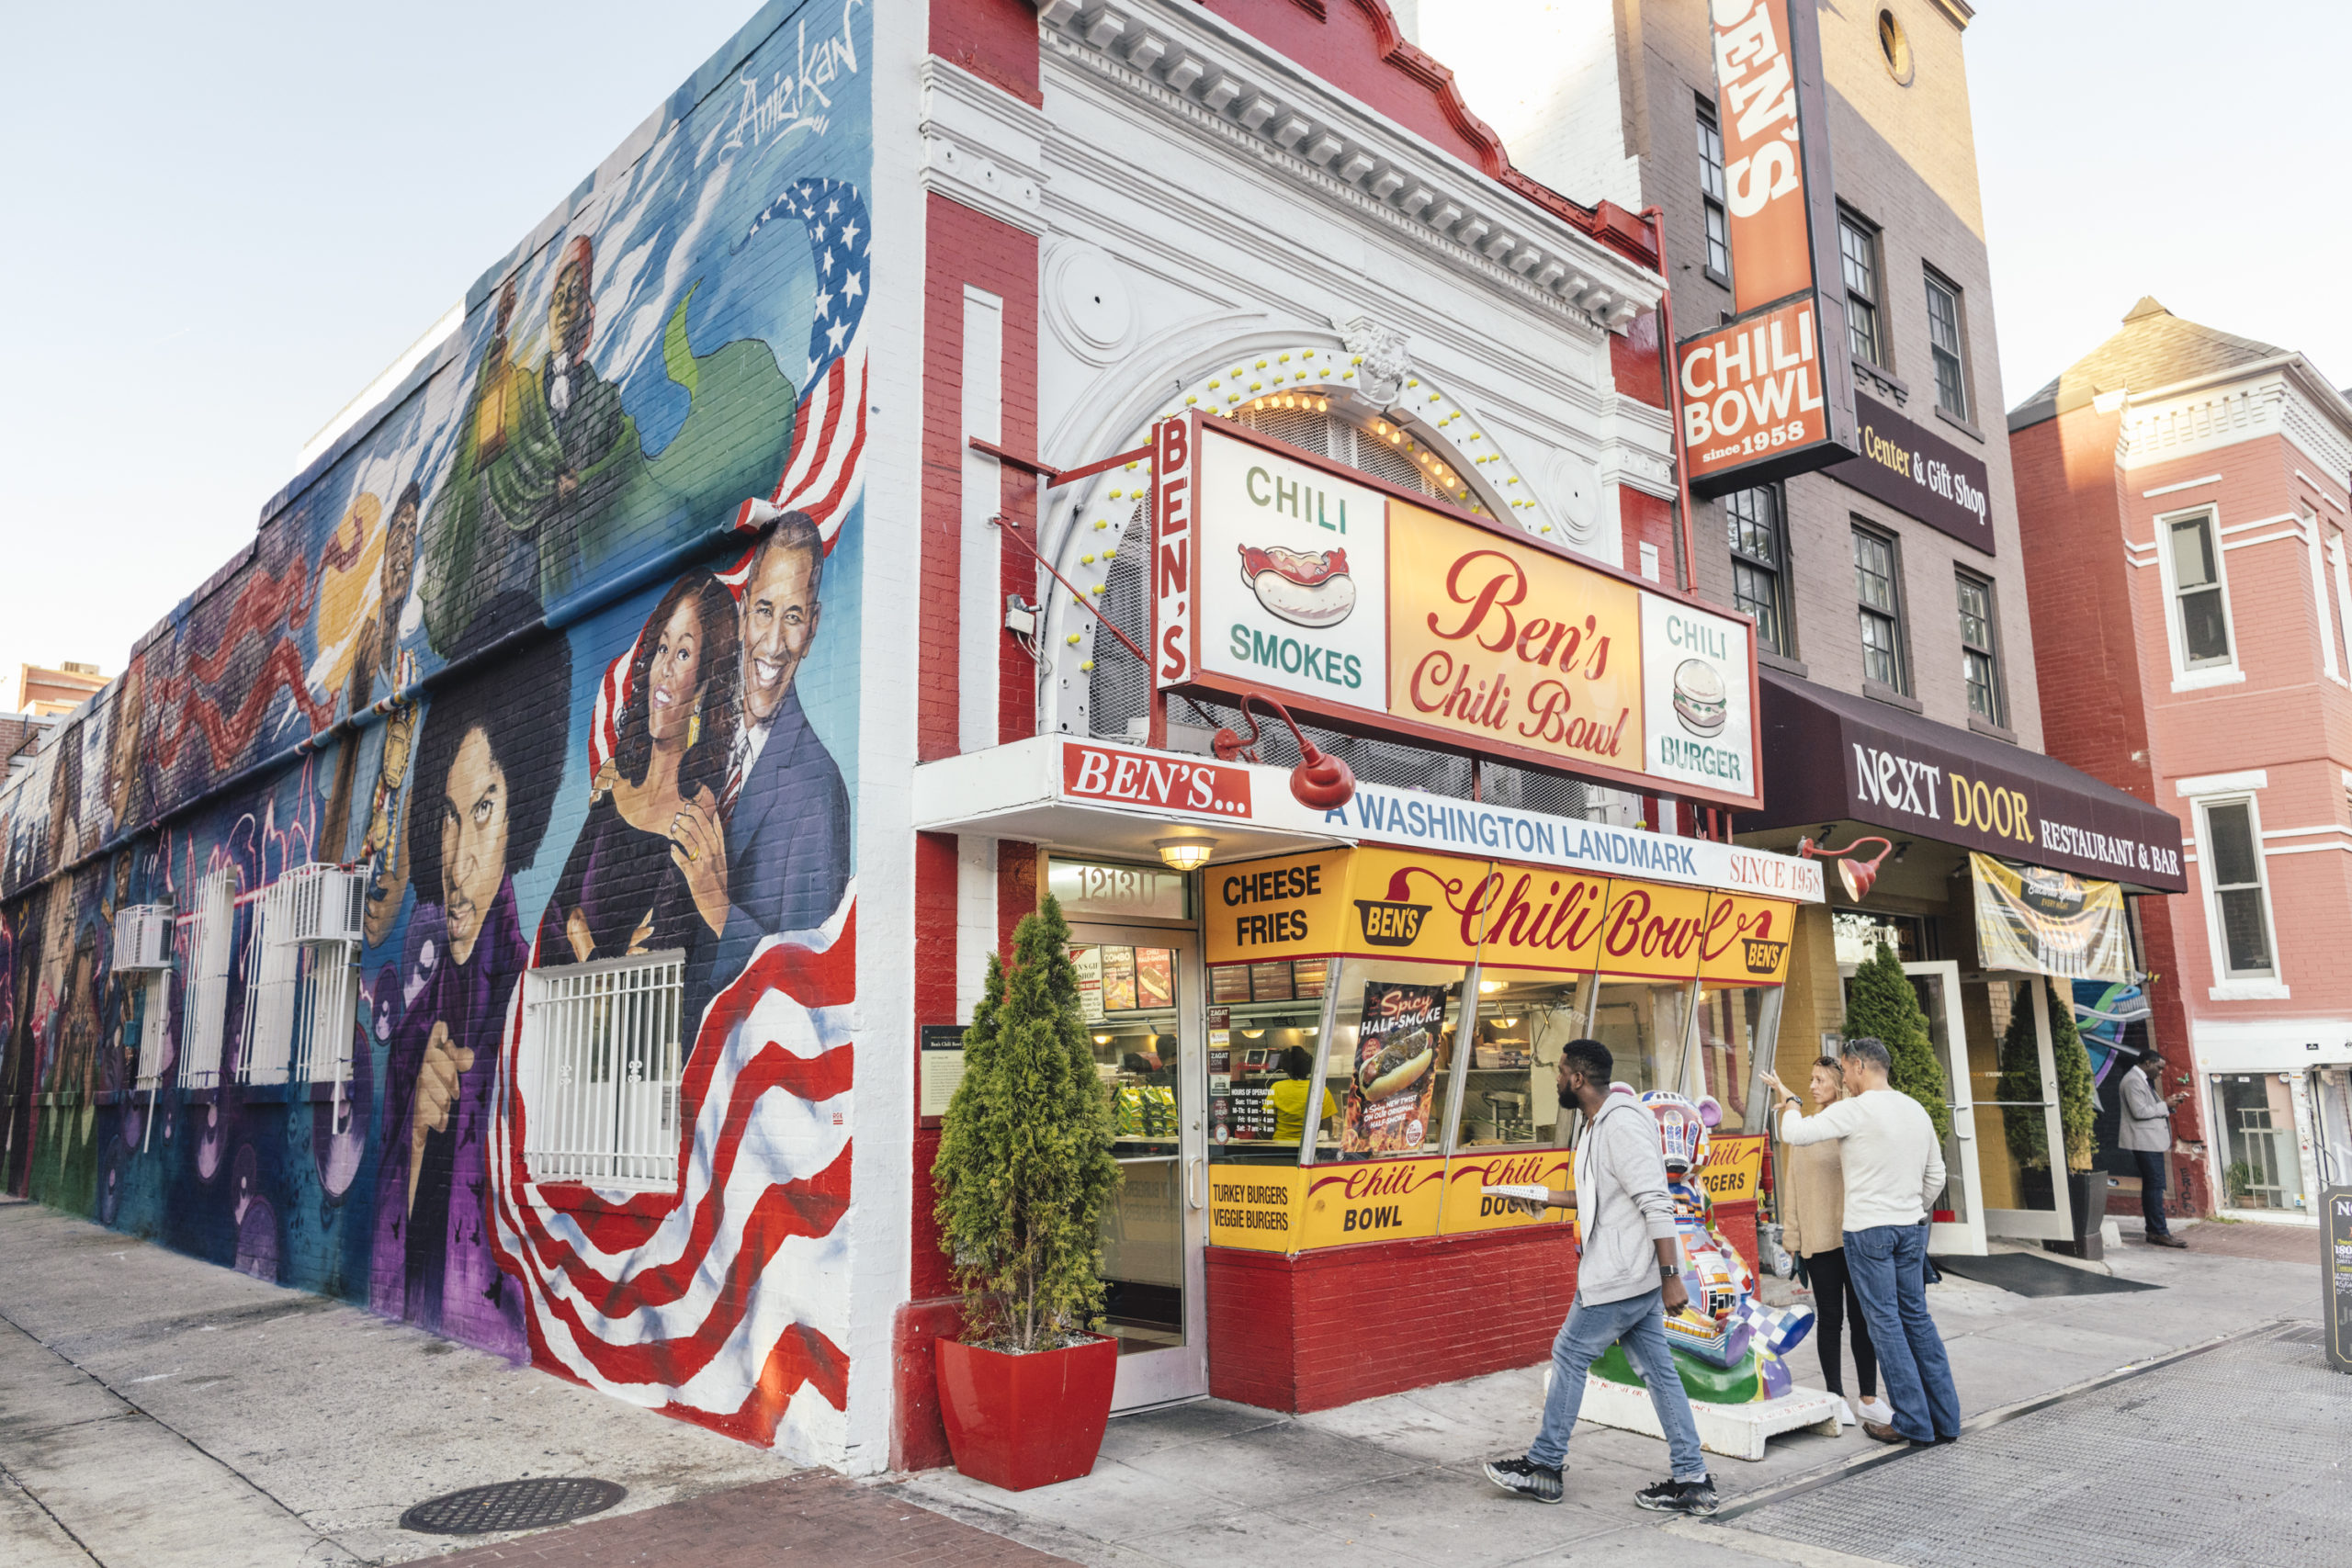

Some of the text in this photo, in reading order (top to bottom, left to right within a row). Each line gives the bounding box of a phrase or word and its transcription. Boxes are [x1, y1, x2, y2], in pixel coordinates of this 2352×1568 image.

[1681, 311, 1814, 398] CHILI
[1685, 367, 1823, 446] BOWL
[1702, 420, 1805, 462] since 1958
[1865, 425, 1910, 478] Center
[1913, 452, 1926, 486] &
[1928, 459, 1953, 500] Gift
[1954, 474, 1985, 525] Shop
[1246, 466, 1348, 535] CHILI
[1161, 417, 1189, 682] BEN'S
[1428, 549, 1611, 681] Ben's
[1229, 623, 1363, 689] SMOKES
[1666, 615, 1726, 660] CHILI
[1409, 649, 1631, 758] Chili Bowl
[1660, 735, 1741, 782] BURGER
[1072, 750, 1247, 814] BEN'S...
[1355, 792, 1554, 852] WASHINGTON
[1562, 825, 1698, 876] LANDMARK
[1729, 854, 1786, 890] SINCE
[1790, 863, 1821, 895] 1958
[1949, 773, 2034, 843] DOOR
[2040, 818, 2136, 869] RESTAURANT
[2138, 845, 2151, 870] &
[2153, 848, 2181, 876] BAR
[1222, 864, 1322, 907] CHEESE
[1237, 908, 1308, 947] FRIES
[1366, 906, 1419, 939] BEN'S
[1460, 871, 1735, 962] Chili Bowl
[1103, 953, 1131, 962] COMBO
[1747, 942, 1781, 969] BEN'S
[1361, 1007, 1442, 1036] HALF-SMOKE
[1381, 990, 1433, 1021] Spicy
[1343, 1163, 1415, 1200] Chili
[1481, 1156, 1544, 1187] Chili
[1702, 1172, 1746, 1192] RGERS
[1213, 1184, 1288, 1206] TURKEY BURGERS
[1480, 1196, 1525, 1217] DO
[2336, 1201, 2352, 1216] N
[1213, 1208, 1288, 1231] VEGGIE BURGERS
[1343, 1204, 1403, 1232] BOWL
